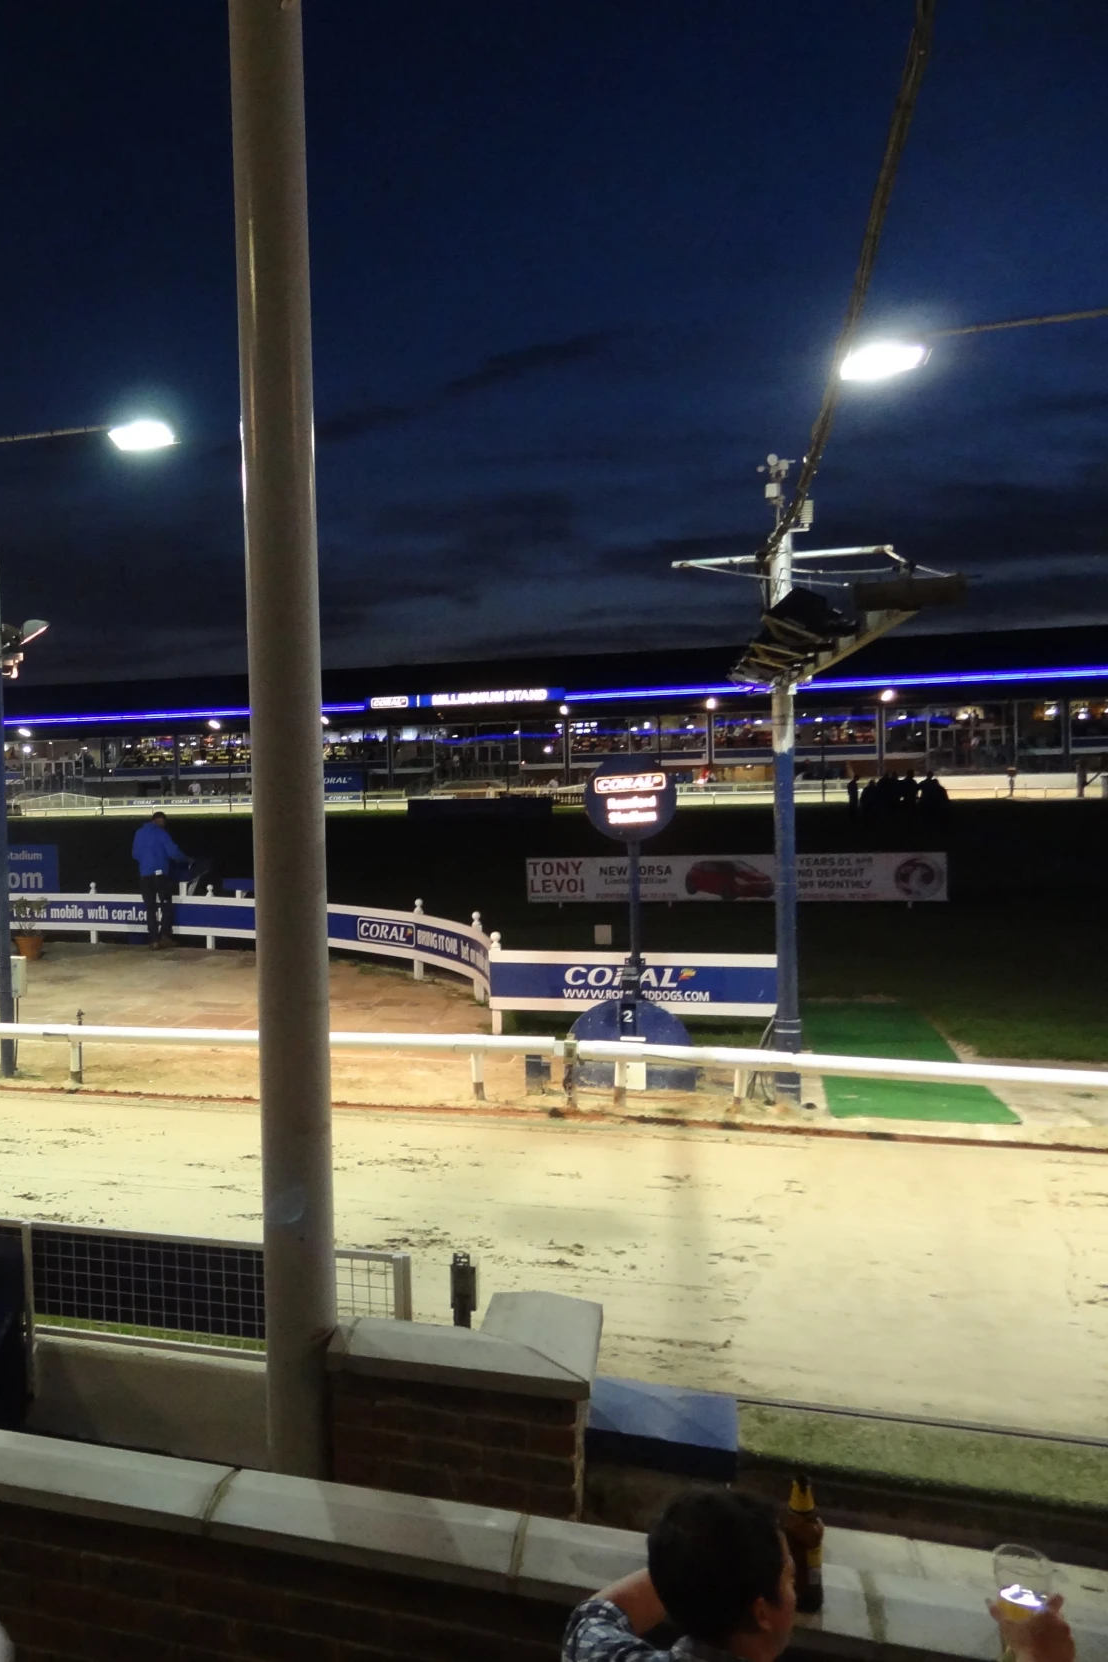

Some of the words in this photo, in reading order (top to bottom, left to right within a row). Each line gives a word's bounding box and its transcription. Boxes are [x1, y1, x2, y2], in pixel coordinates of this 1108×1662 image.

[505, 689, 548, 702] STAND
[323, 776, 348, 784] ORAL
[597, 776, 653, 791] CORAL
[8, 850, 43, 861] tadium
[529, 861, 583, 876] TONY
[599, 866, 628, 876] NEW
[639, 865, 672, 876] ORSA
[817, 868, 864, 878] DEPOSIT
[818, 879, 872, 889] MONTHLY
[50, 905, 84, 919] mobile
[87, 905, 109, 920] with
[360, 922, 407, 943] CORAL
[622, 1010, 633, 1024] 2
